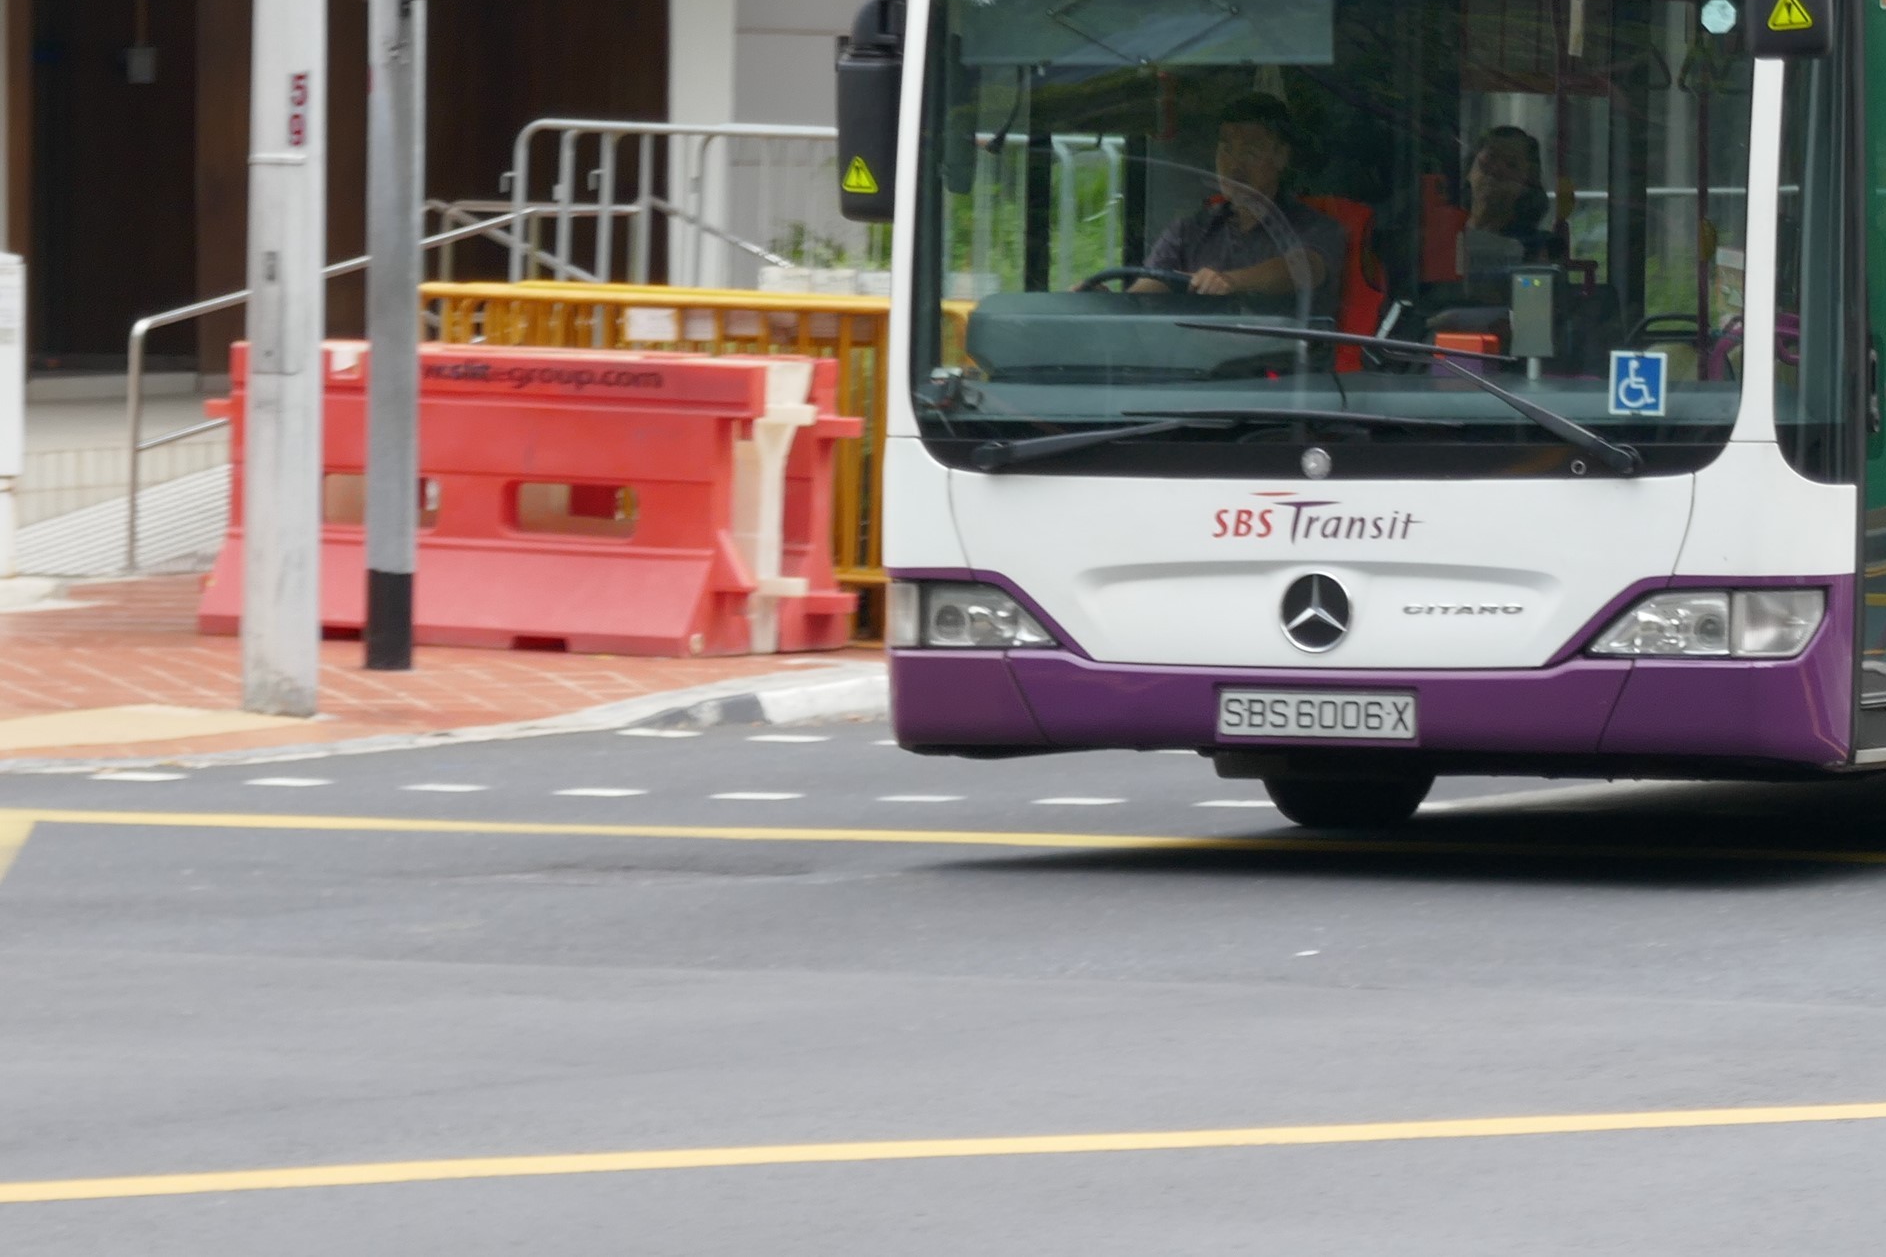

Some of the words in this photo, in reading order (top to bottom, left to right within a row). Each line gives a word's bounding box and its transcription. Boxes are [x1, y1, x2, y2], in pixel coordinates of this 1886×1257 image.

[1212, 508, 1274, 539] SBS
[1272, 500, 1426, 546] Transit
[1224, 697, 1410, 732] SBS6006X
